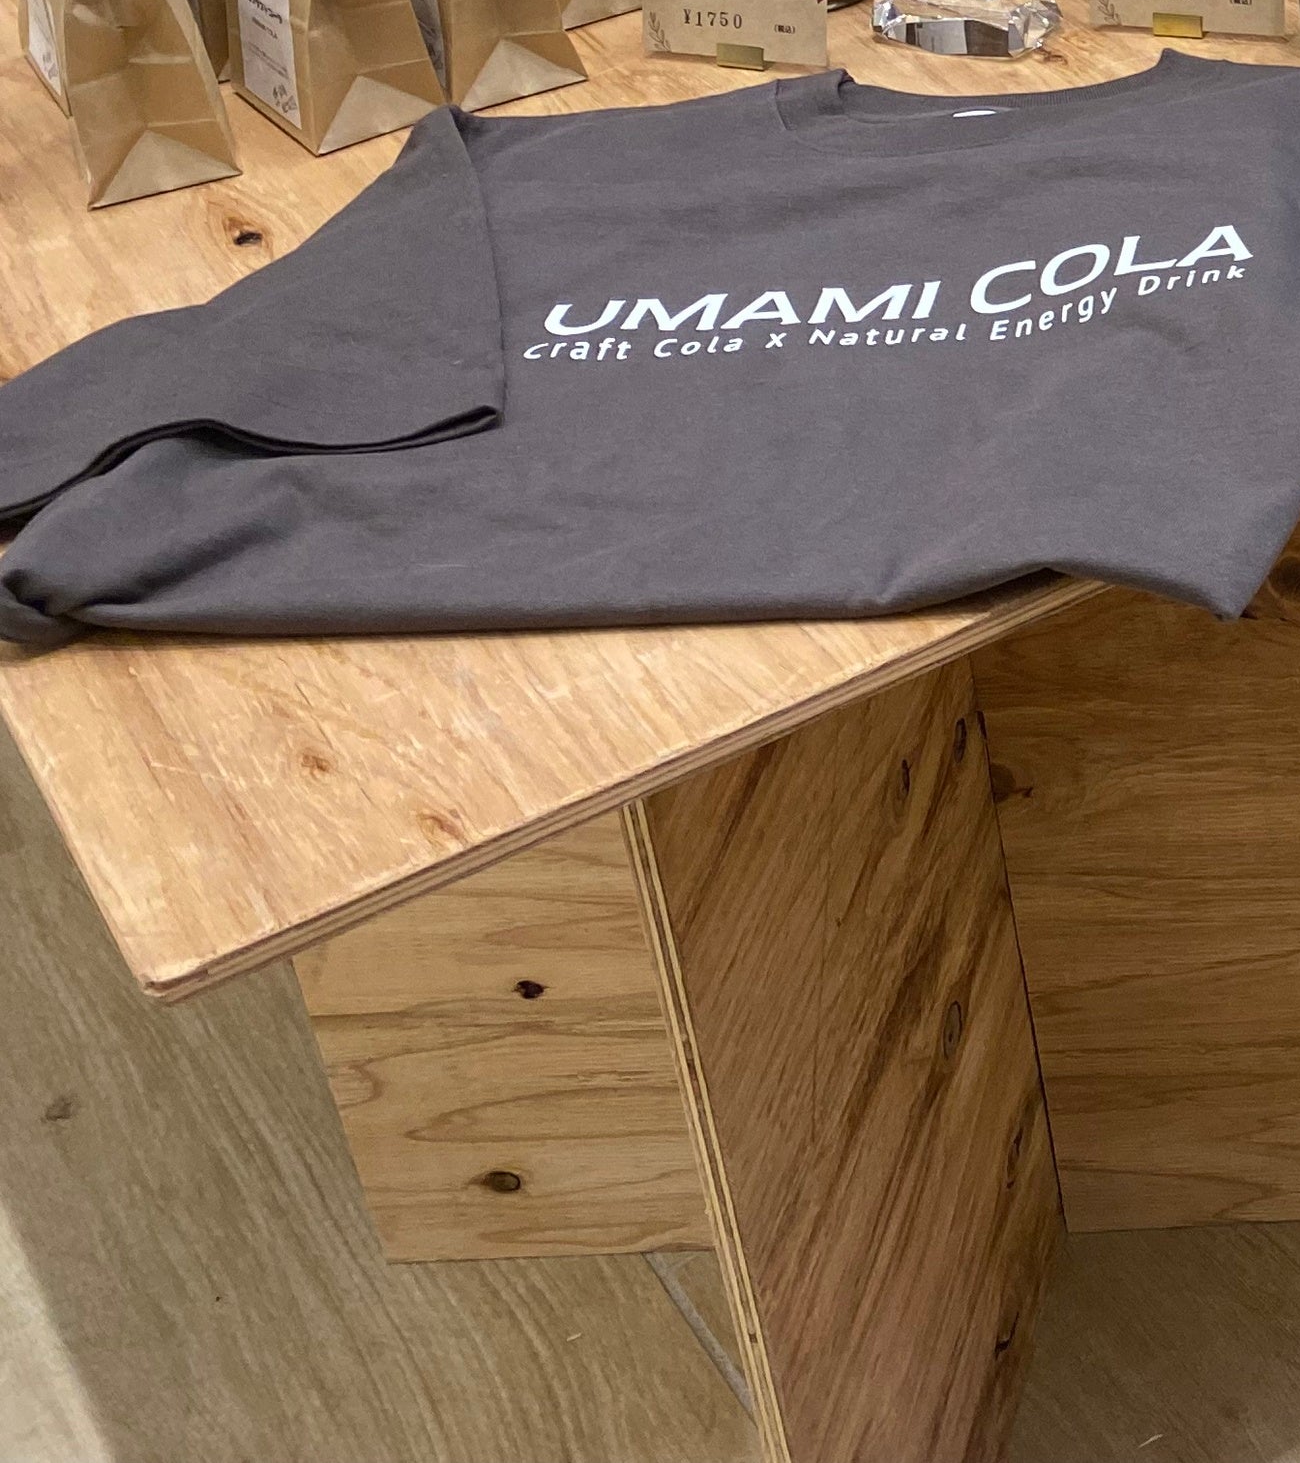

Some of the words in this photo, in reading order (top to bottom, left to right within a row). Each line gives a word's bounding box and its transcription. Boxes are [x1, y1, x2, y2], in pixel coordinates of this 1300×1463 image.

[683, 8, 743, 29] ¥1750
[544, 279, 941, 336] UMAMI
[969, 223, 1255, 315] COLA
[653, 336, 744, 358] Cola
[808, 322, 967, 346] Natural
[990, 287, 1118, 341] Energy
[1138, 263, 1248, 296] Drink
